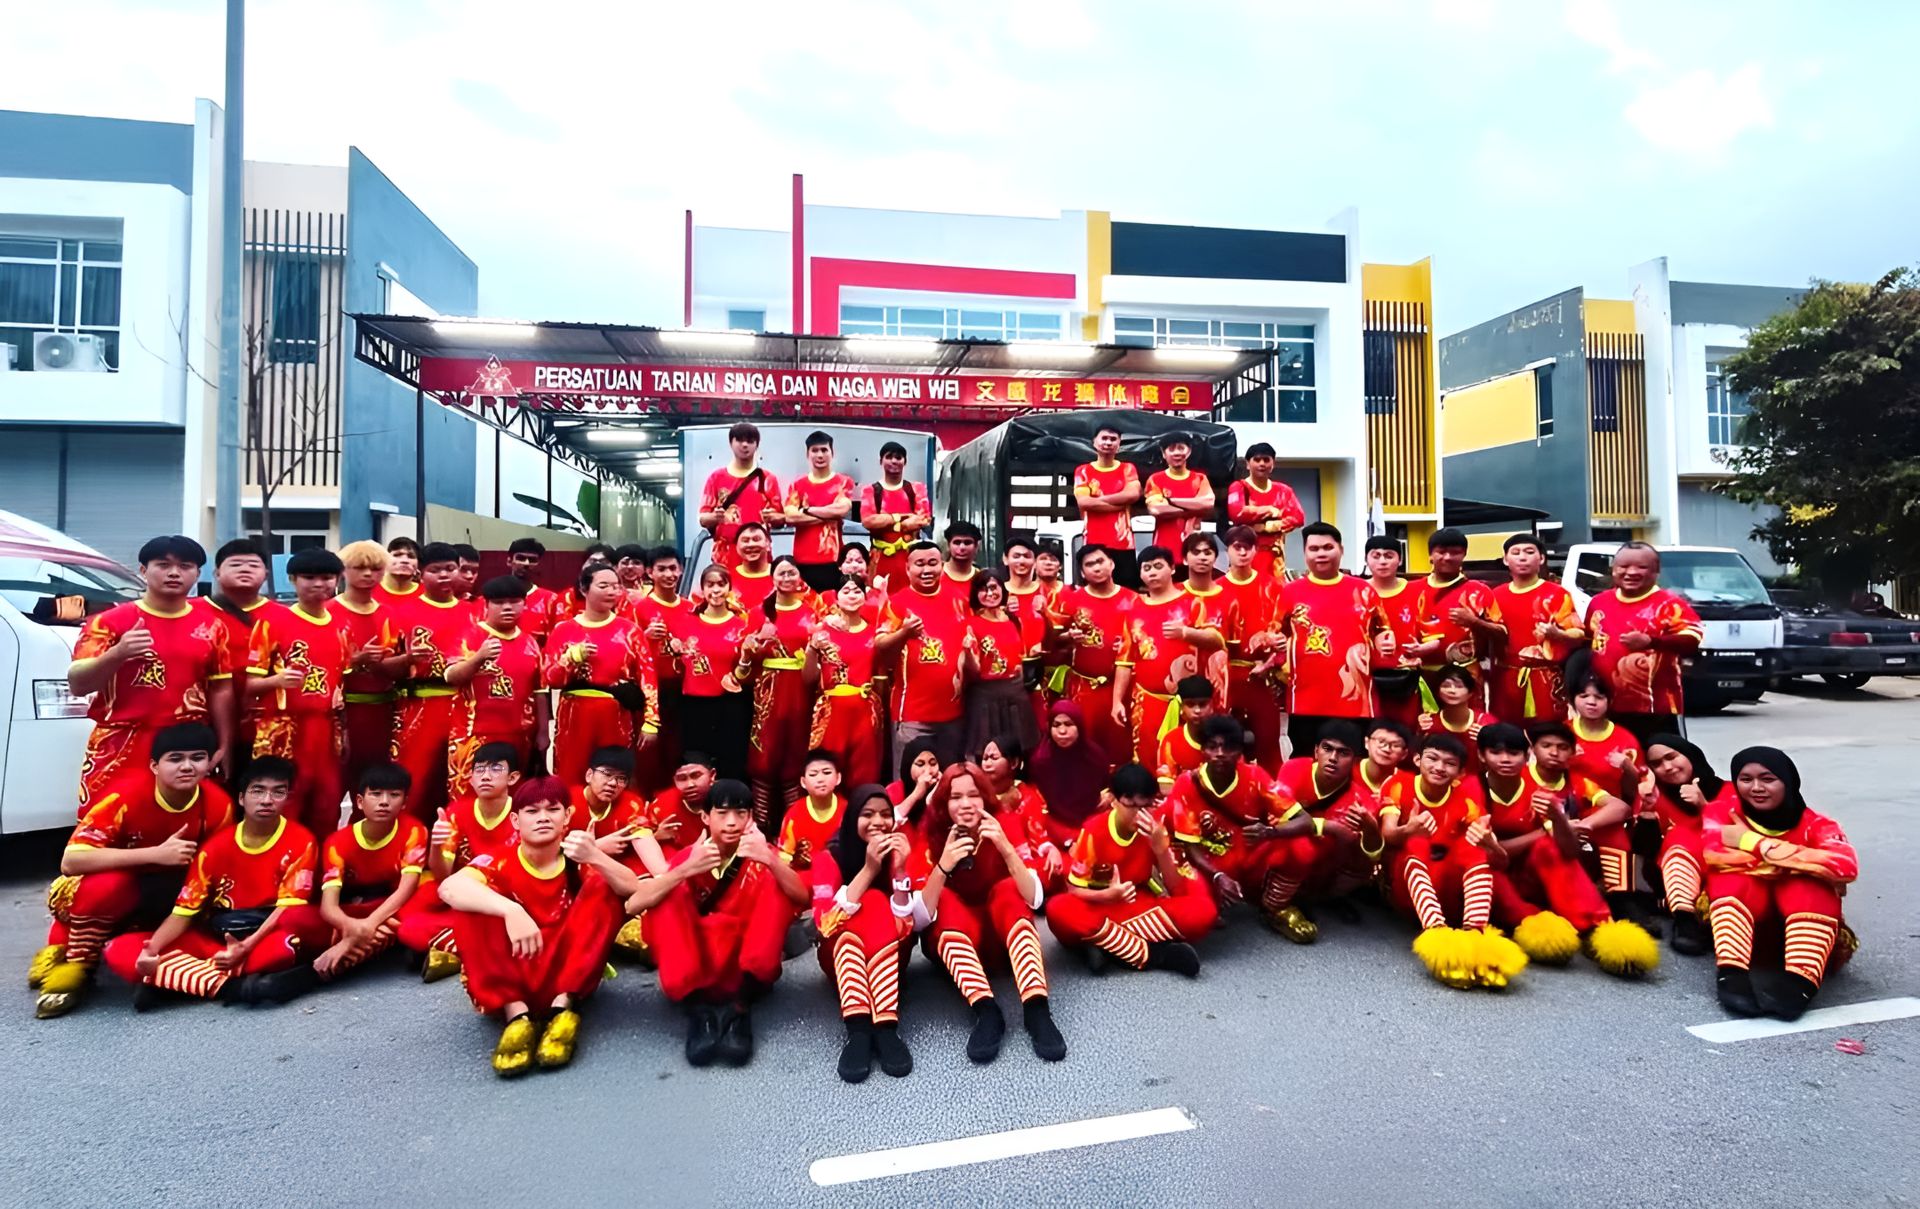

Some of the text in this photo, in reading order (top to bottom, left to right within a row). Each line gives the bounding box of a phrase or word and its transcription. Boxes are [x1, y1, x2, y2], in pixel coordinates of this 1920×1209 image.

[534, 367, 643, 393] PERSATUAN
[651, 371, 715, 394] TARIAN
[723, 373, 777, 396] SINGA
[781, 375, 818, 397] DAN
[828, 377, 877, 399] NAGA
[881, 378, 921, 400] WEN
